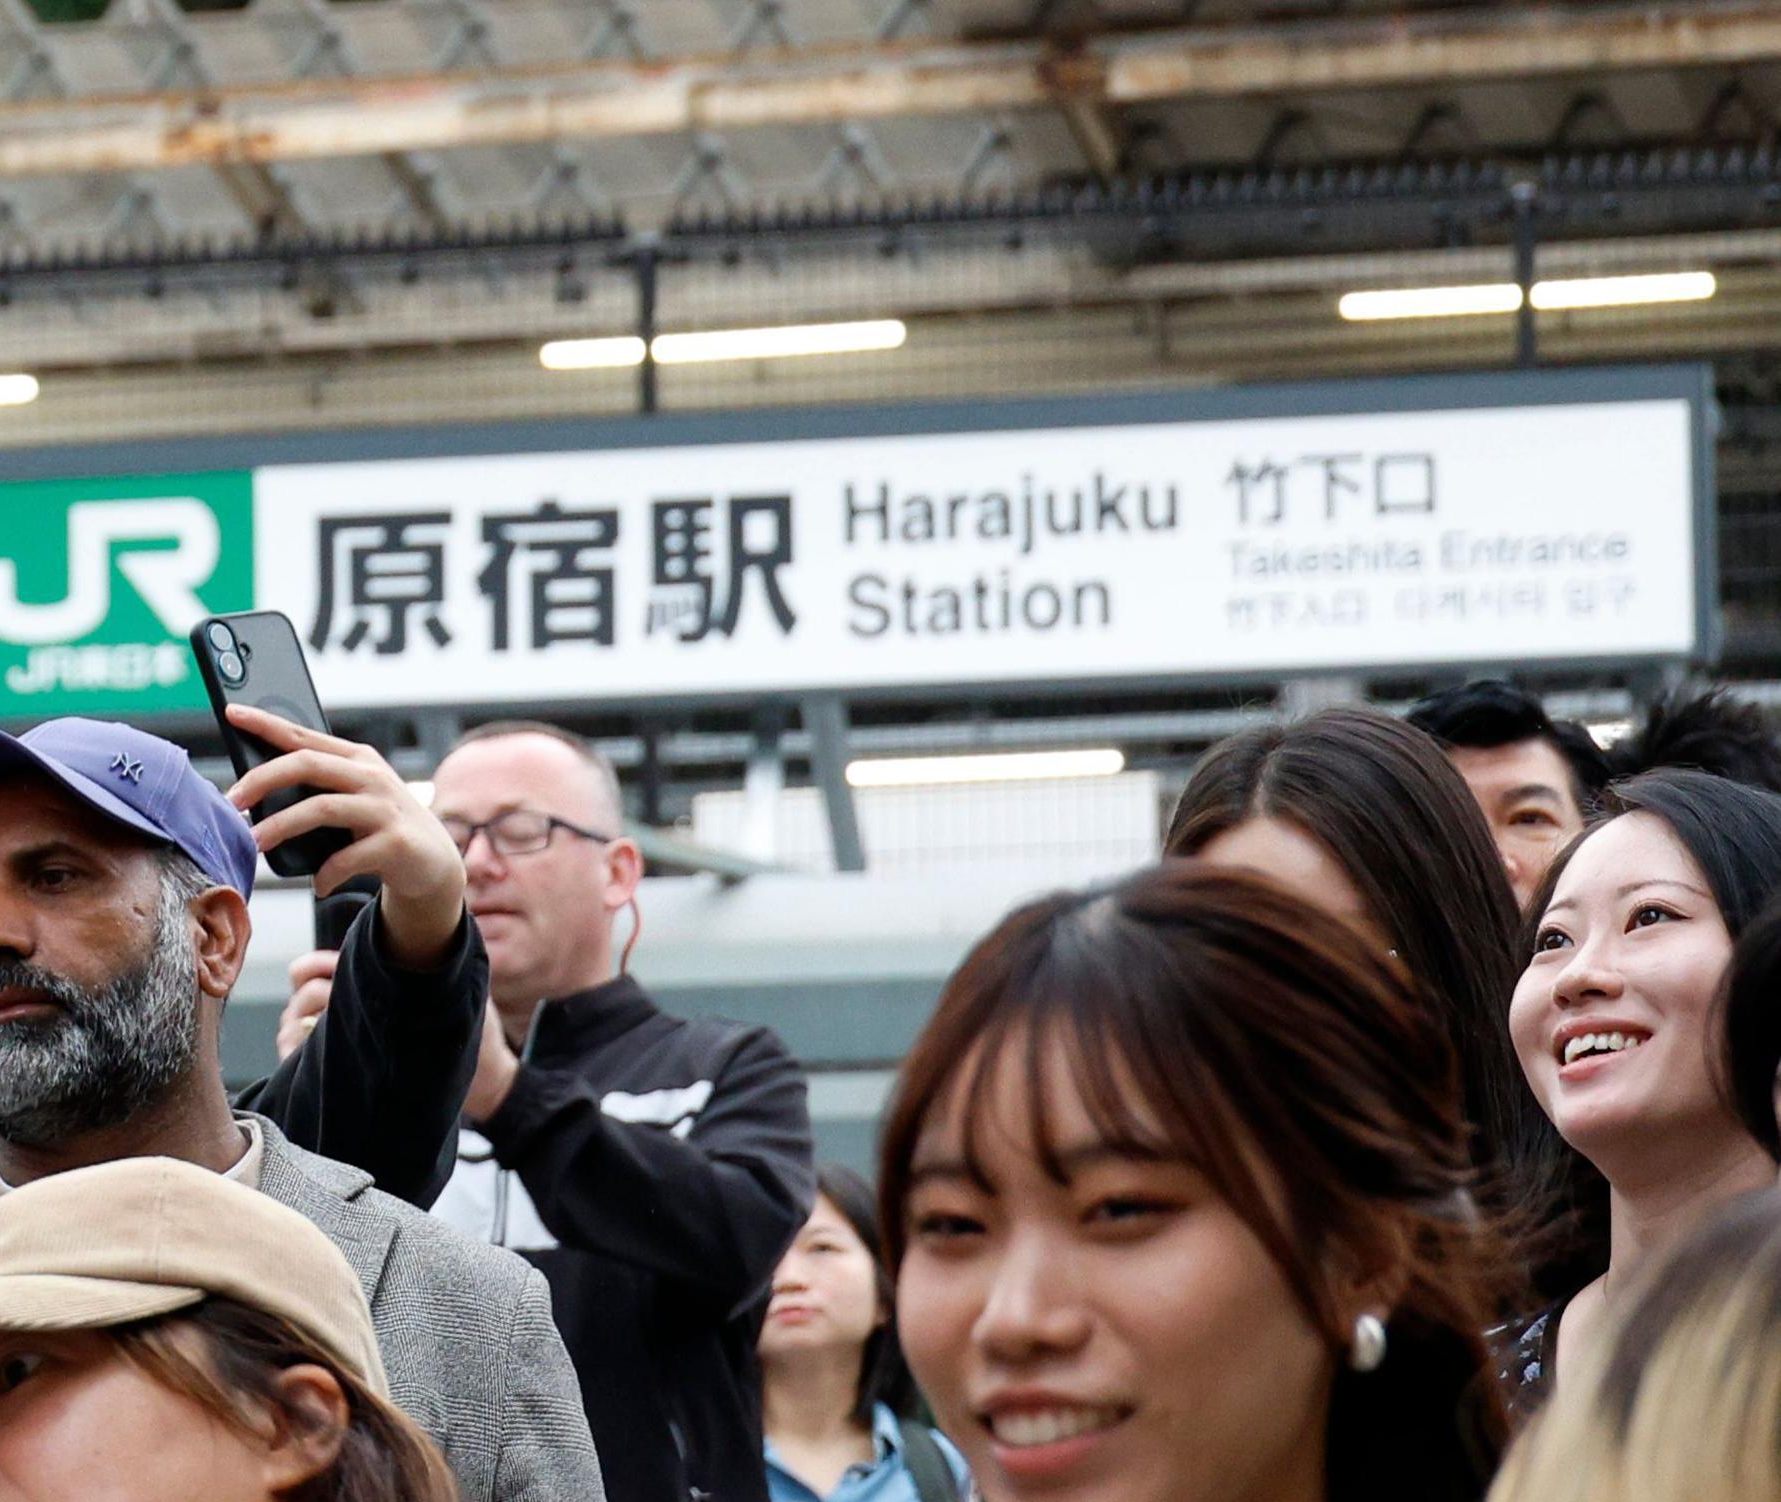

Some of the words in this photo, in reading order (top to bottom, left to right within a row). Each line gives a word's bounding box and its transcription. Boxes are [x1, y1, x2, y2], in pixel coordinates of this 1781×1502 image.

[843, 472, 1180, 555] Harajuku
[1224, 451, 1435, 525] 竹下口
[307, 494, 798, 656] 原宿駅
[1440, 530, 1632, 570] Entrance
[846, 569, 1112, 638] Station
